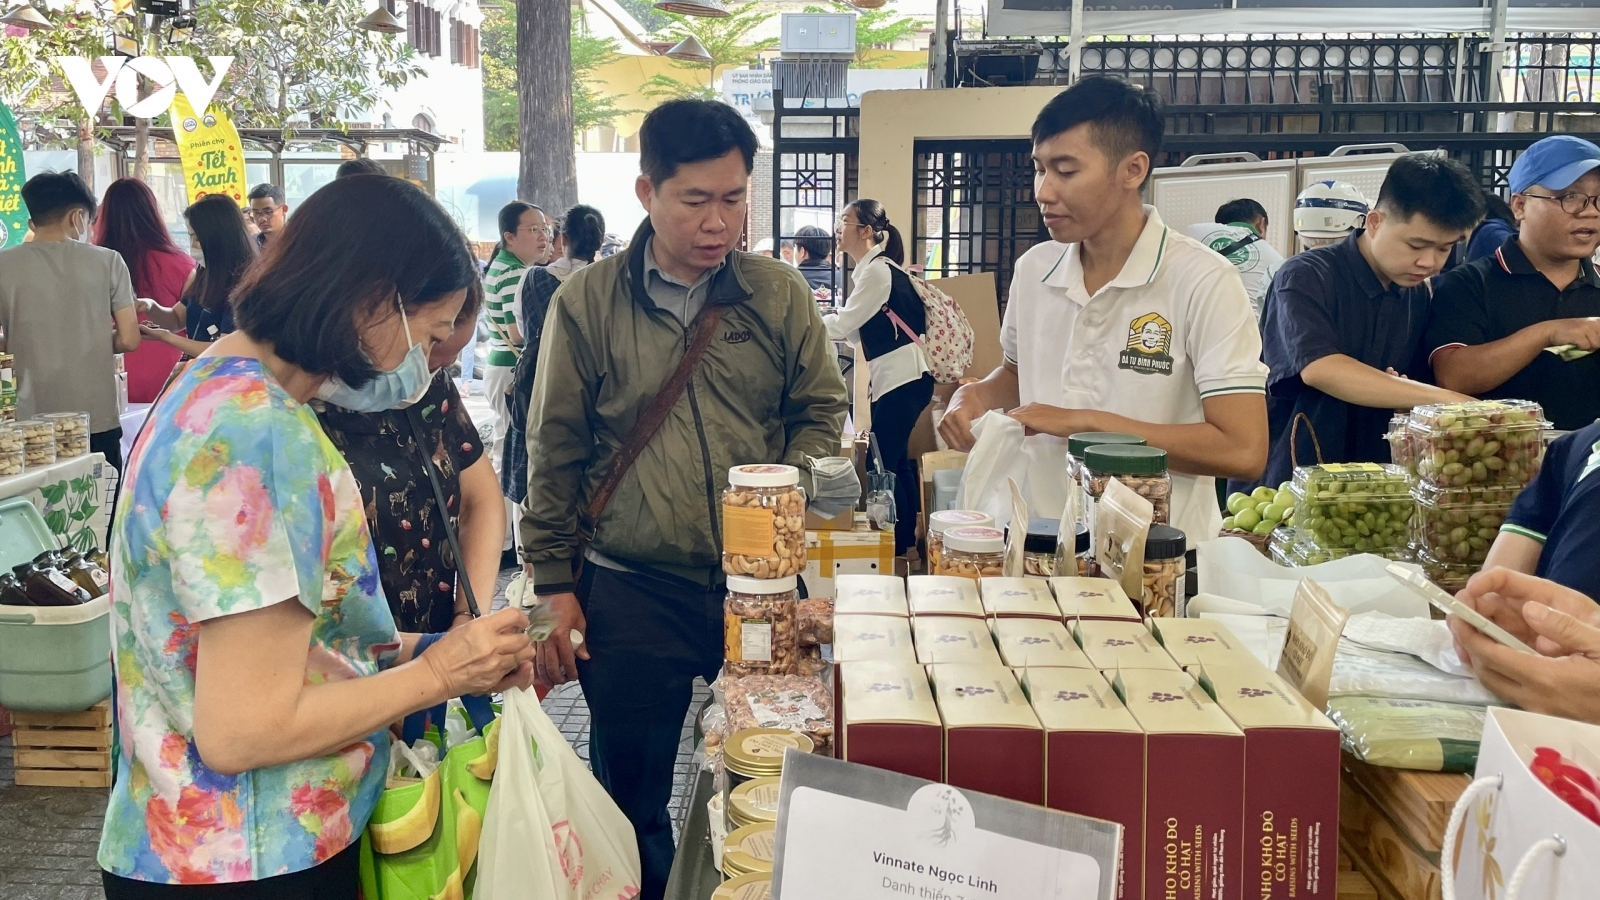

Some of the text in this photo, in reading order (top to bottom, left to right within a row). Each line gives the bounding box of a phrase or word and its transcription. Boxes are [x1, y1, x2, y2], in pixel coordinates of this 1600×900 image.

[190, 141, 211, 149] Phiên
[200, 149, 227, 170] Tết
[191, 166, 238, 189] Xanh
[0, 193, 20, 215] iệt
[1259, 810, 1274, 832] ĐỎ
[1194, 824, 1203, 848] SEEDS
[1163, 817, 1178, 900] HO KHÔ ĐỎ
[1259, 836, 1273, 866] KHÔ
[1273, 832, 1289, 882] CÓ HẠT
[1288, 817, 1298, 898] RAISINS WITH SEEDS
[873, 850, 998, 893] Vinnate Ngọc Linh
[1178, 840, 1193, 889] CÓ HẠT
[592, 866, 614, 895] CHAY
[882, 876, 915, 896] Danh
